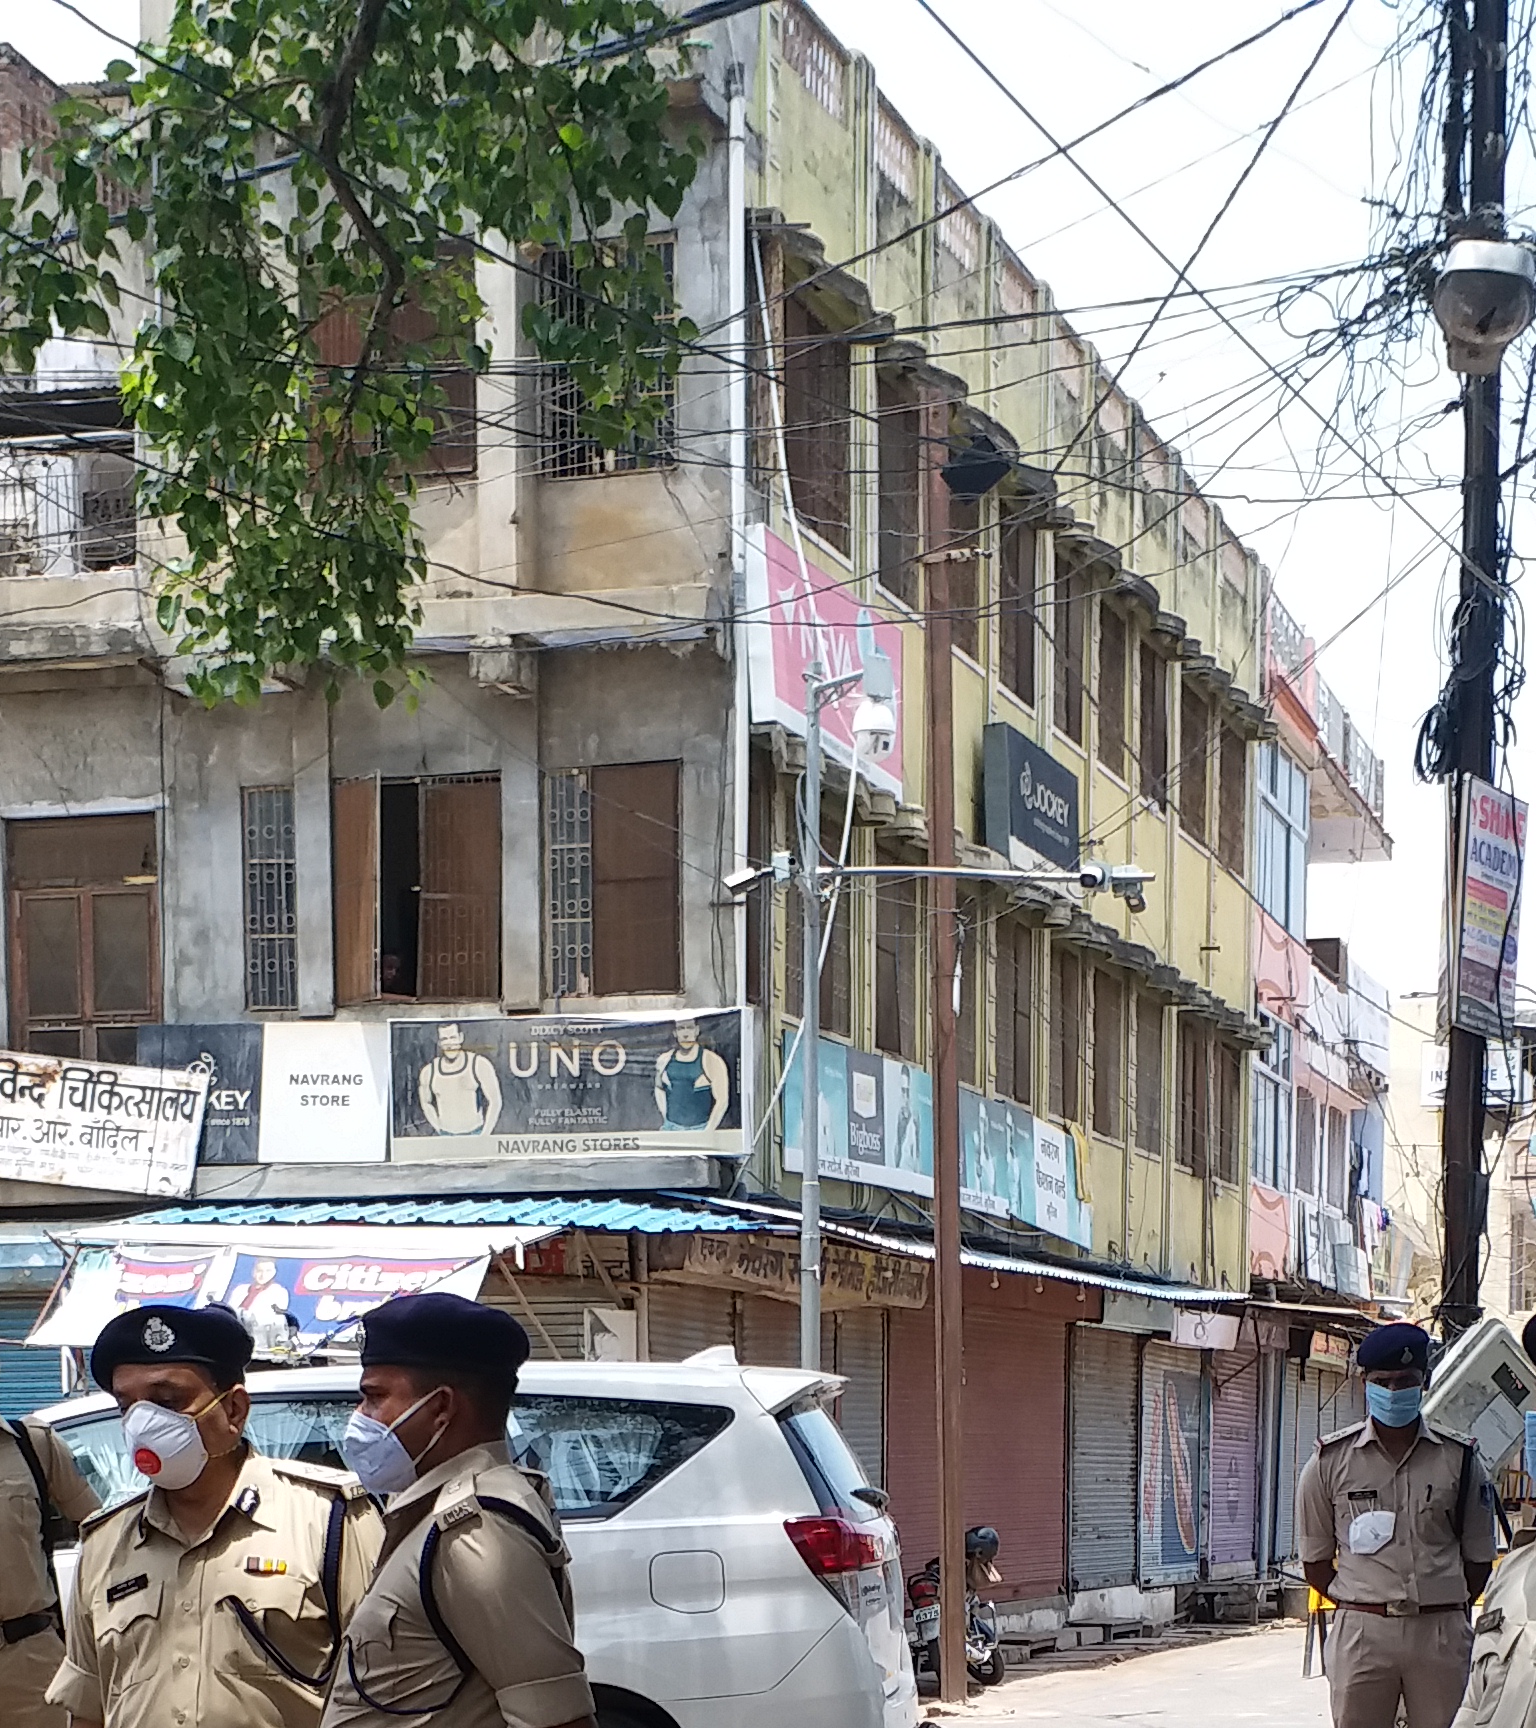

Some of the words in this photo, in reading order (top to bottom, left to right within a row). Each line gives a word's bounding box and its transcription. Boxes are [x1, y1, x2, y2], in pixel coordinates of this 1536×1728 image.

[1033, 783, 1069, 828] JOCKEY
[1470, 836, 1517, 880] ACADEM
[509, 1039, 627, 1079] UNO
[288, 1073, 364, 1086] NAVRANG
[59, 1066, 202, 1124] चिकित्सालय
[300, 1093, 351, 1107] STORE
[534, 1107, 563, 1117] FULLY
[564, 1107, 602, 1116] ELASTIC
[557, 1115, 608, 1126] FANTASTIC
[498, 1139, 577, 1154] NAVRANG
[582, 1137, 641, 1151] STORES
[850, 1122, 881, 1155] Bigboss
